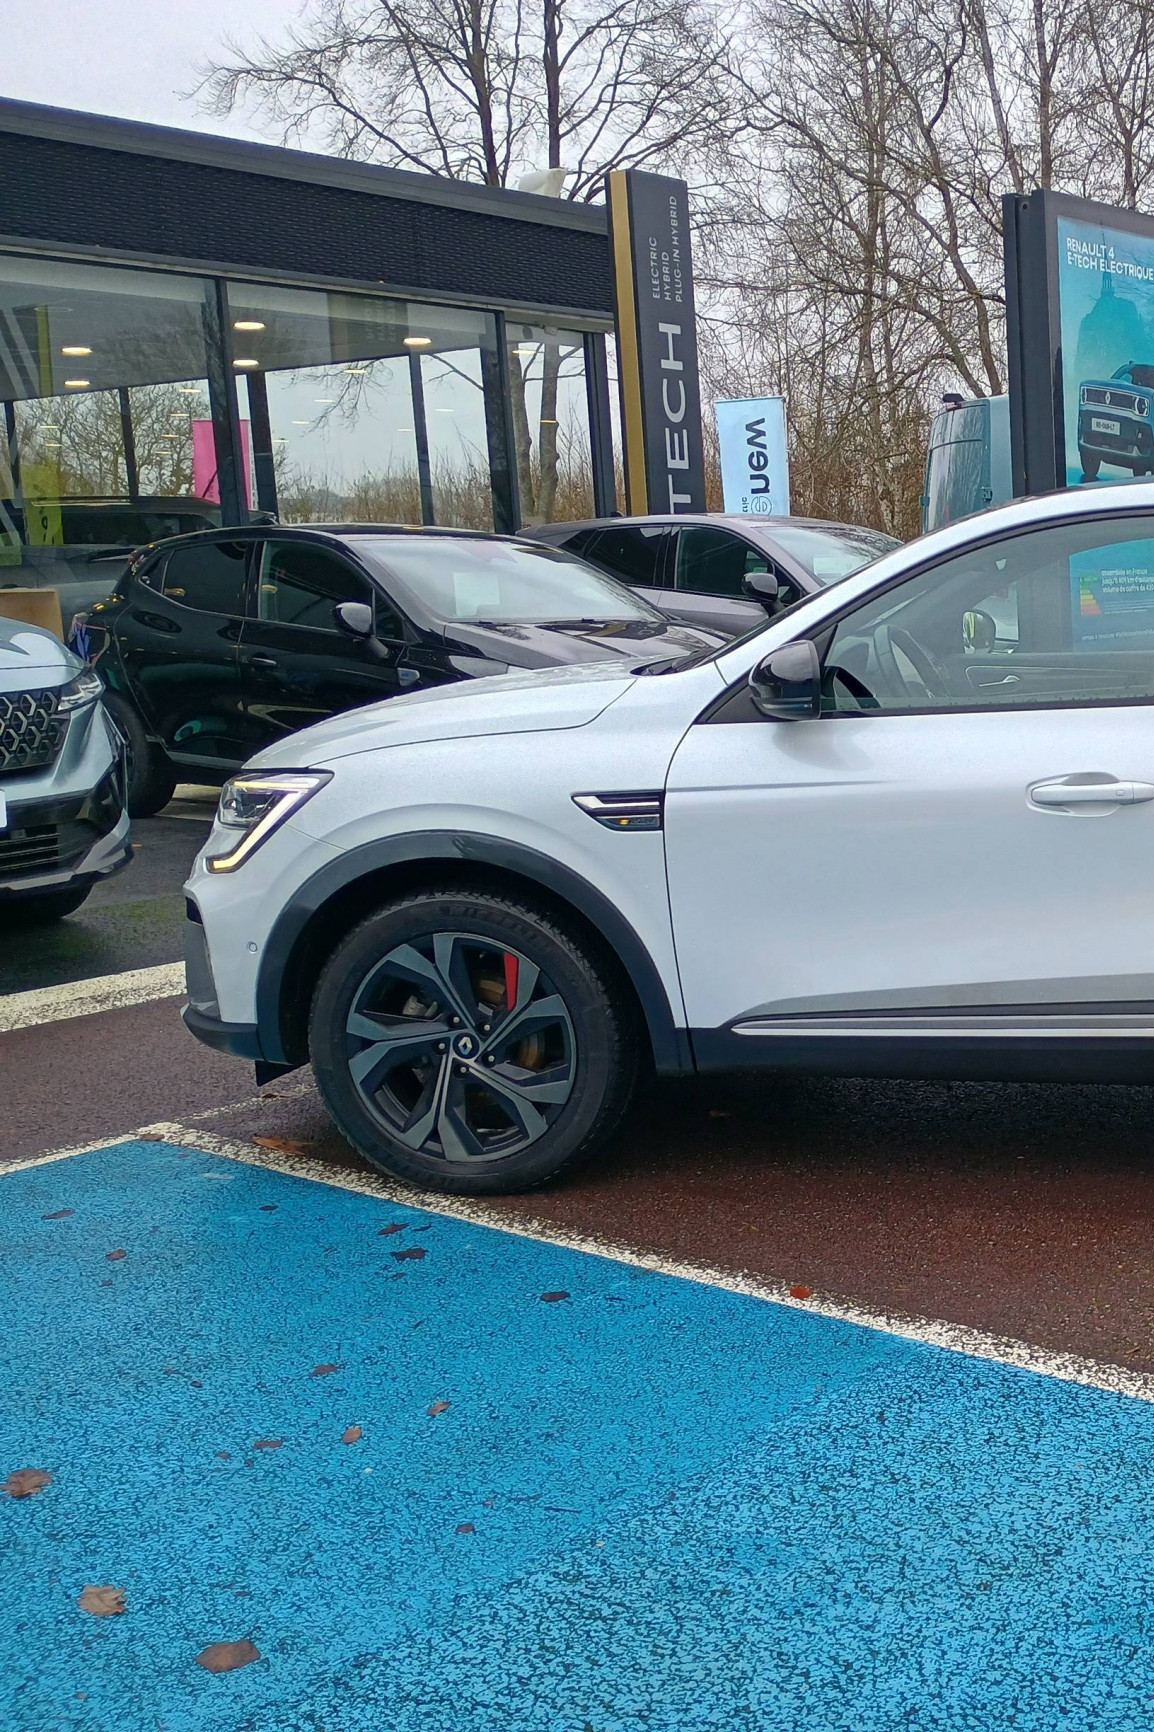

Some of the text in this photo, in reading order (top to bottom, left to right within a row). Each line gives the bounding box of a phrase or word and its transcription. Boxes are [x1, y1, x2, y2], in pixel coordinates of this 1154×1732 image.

[648, 236, 661, 299] ELECTRIC
[661, 251, 672, 301] HYBRID
[669, 195, 683, 303] PLUG-IN HYBRID
[1066, 237, 1115, 259] RENAULT 4
[1067, 252, 1098, 270] E-TECH
[658, 322, 692, 514] TECH
